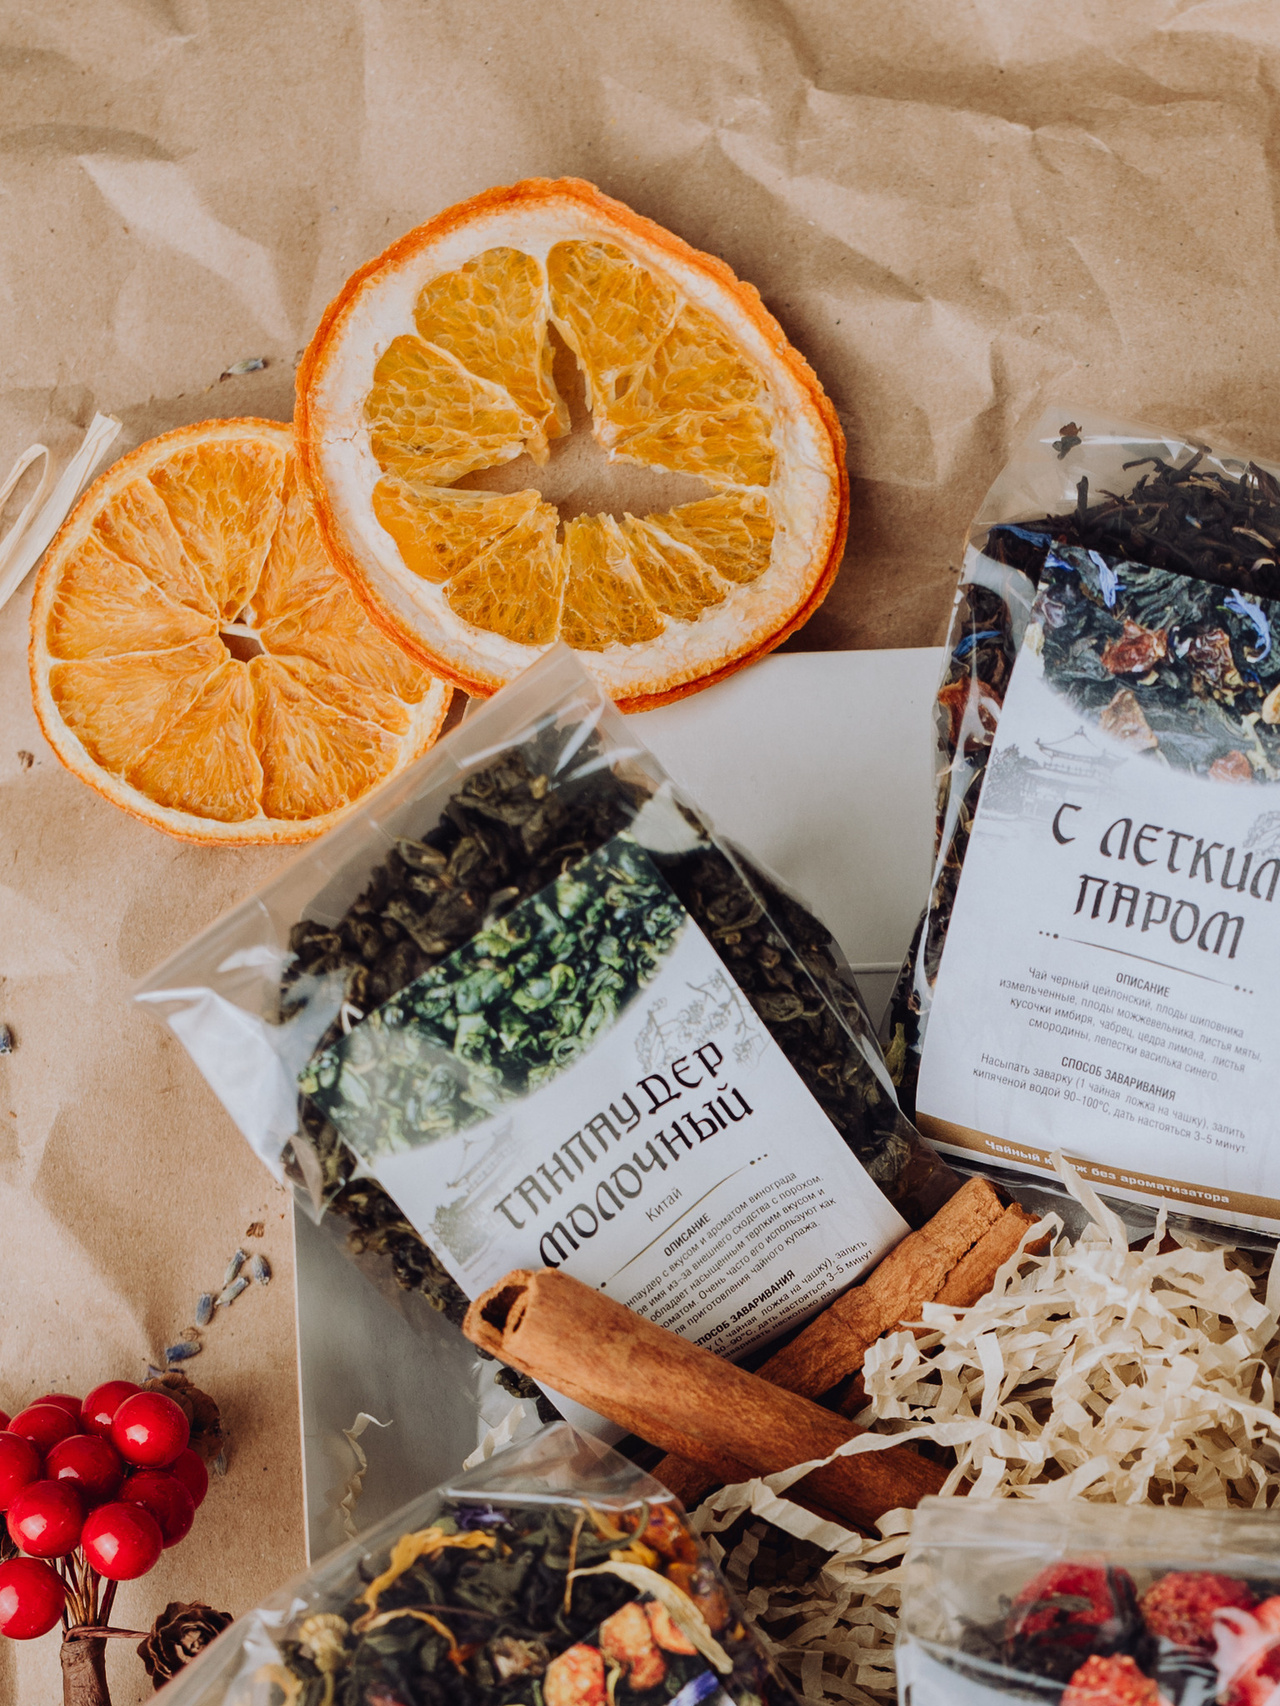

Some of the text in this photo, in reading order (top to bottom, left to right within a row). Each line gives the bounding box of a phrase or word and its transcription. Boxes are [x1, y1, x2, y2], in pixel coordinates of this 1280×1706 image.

[1073, 873, 1245, 959] ПАРОМ
[998, 978, 1265, 1061] измельченные, плоды можжевельника, листья мяты,
[1026, 966, 1246, 1039] Чай черный цейлонский, плоды шиповника
[1114, 971, 1172, 999] ОПИСАНИЕ
[1008, 997, 1247, 1073] кусочки имбиря, чабрец, цедра лимона, листья
[1027, 1017, 1223, 1082] смородины, лепестки василька синего.
[971, 1067, 1029, 1091] кипяченой
[1027, 1082, 1063, 1099] водой
[1112, 1107, 1137, 1122] дать
[1136, 1115, 1194, 1139] настояться
[979, 1052, 1248, 1140] Насыпать заварку (1 чайная ложка на чашку), залить
[1060, 1055, 1178, 1102] СПОСОБ ЗАВАРИВАНИЯ
[538, 1082, 755, 1269] МОЛОЧНЫЙ
[644, 1187, 683, 1223] Китай
[984, 1138, 1041, 1162] Чайный
[1091, 1165, 1116, 1181] без
[1120, 1171, 1230, 1204] ароматизатора
[620, 1171, 798, 1314] нпаудер с вкусом и ароматом винограда
[647, 1288, 668, 1308] имя
[690, 1232, 734, 1272] внешнего
[731, 1201, 772, 1236] сходства
[769, 1196, 780, 1205] с
[777, 1172, 823, 1201] порохом.
[648, 1187, 826, 1323] обладает насыщенным терпким вкусом и
[662, 1212, 712, 1258] ОПИСАНИЕ
[697, 1275, 728, 1301] Очень
[725, 1253, 751, 1279] часто
[748, 1241, 767, 1258] его
[764, 1204, 819, 1245] используют
[817, 1196, 837, 1210] как
[672, 1218, 820, 1336] ля приготовления чайного купажа.
[723, 1312, 759, 1342] чайная
[757, 1290, 792, 1317] ложка
[787, 1281, 803, 1297] на
[799, 1255, 838, 1288] чашку),
[833, 1236, 869, 1263] залить
[728, 1268, 796, 1324] ЗАВАРИВАНИЯ
[754, 1311, 781, 1333] дать
[776, 1277, 829, 1318] настояться
